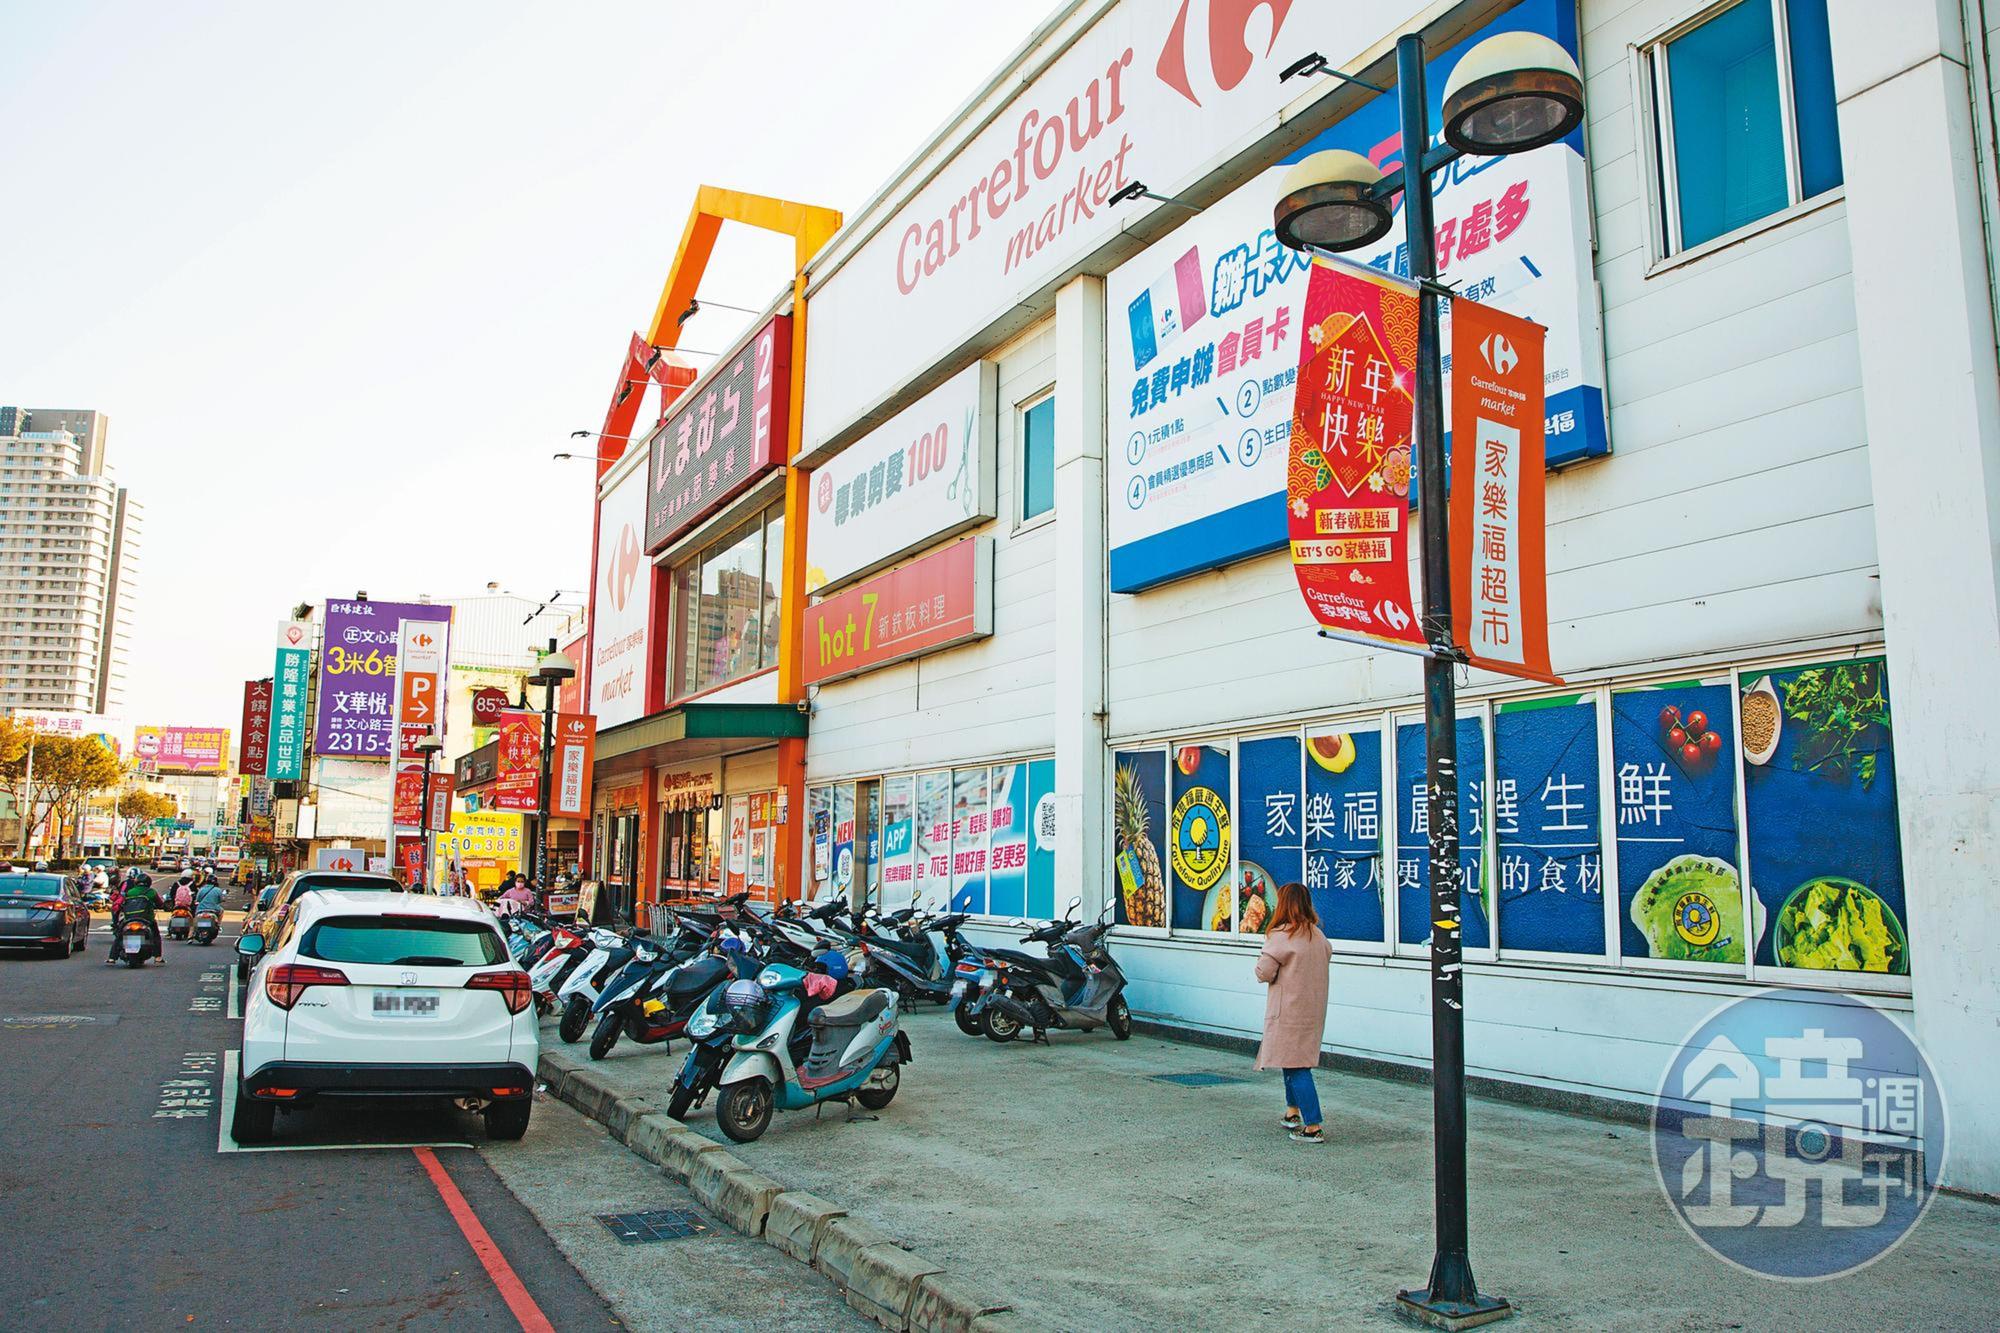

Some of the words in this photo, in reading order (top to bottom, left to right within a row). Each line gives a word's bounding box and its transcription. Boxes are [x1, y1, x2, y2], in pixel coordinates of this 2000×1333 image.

[897, 47, 1133, 295] Carrefour
[1004, 132, 1133, 275] market
[1325, 344, 1388, 404] 新年
[1471, 375, 1507, 396] Carrefour
[754, 334, 771, 464] 2F
[1320, 392, 1345, 405] HAPPY
[1347, 399, 1364, 409] NEW
[1366, 403, 1385, 415] YEAR
[1480, 396, 1517, 417] market
[657, 360, 745, 494] しまむら
[1319, 403, 1386, 463] 快樂
[1319, 511, 1390, 530] 新春就是福
[1296, 546, 1322, 558] LET'S
[1326, 545, 1343, 557] GO
[1344, 540, 1387, 560] 家樂福
[1481, 439, 1510, 646] 家樂福超市
[1306, 587, 1365, 609] Carrefour
[1318, 603, 1372, 624] 家樂福
[819, 613, 856, 667] hot
[861, 592, 879, 652] 7
[597, 637, 627, 668] Carrefour
[412, 677, 431, 699] P
[601, 664, 635, 703] market
[566, 750, 580, 808] 家樂福超市
[886, 828, 905, 852] APP
[1307, 854, 1601, 894] 給家人更心的食材
